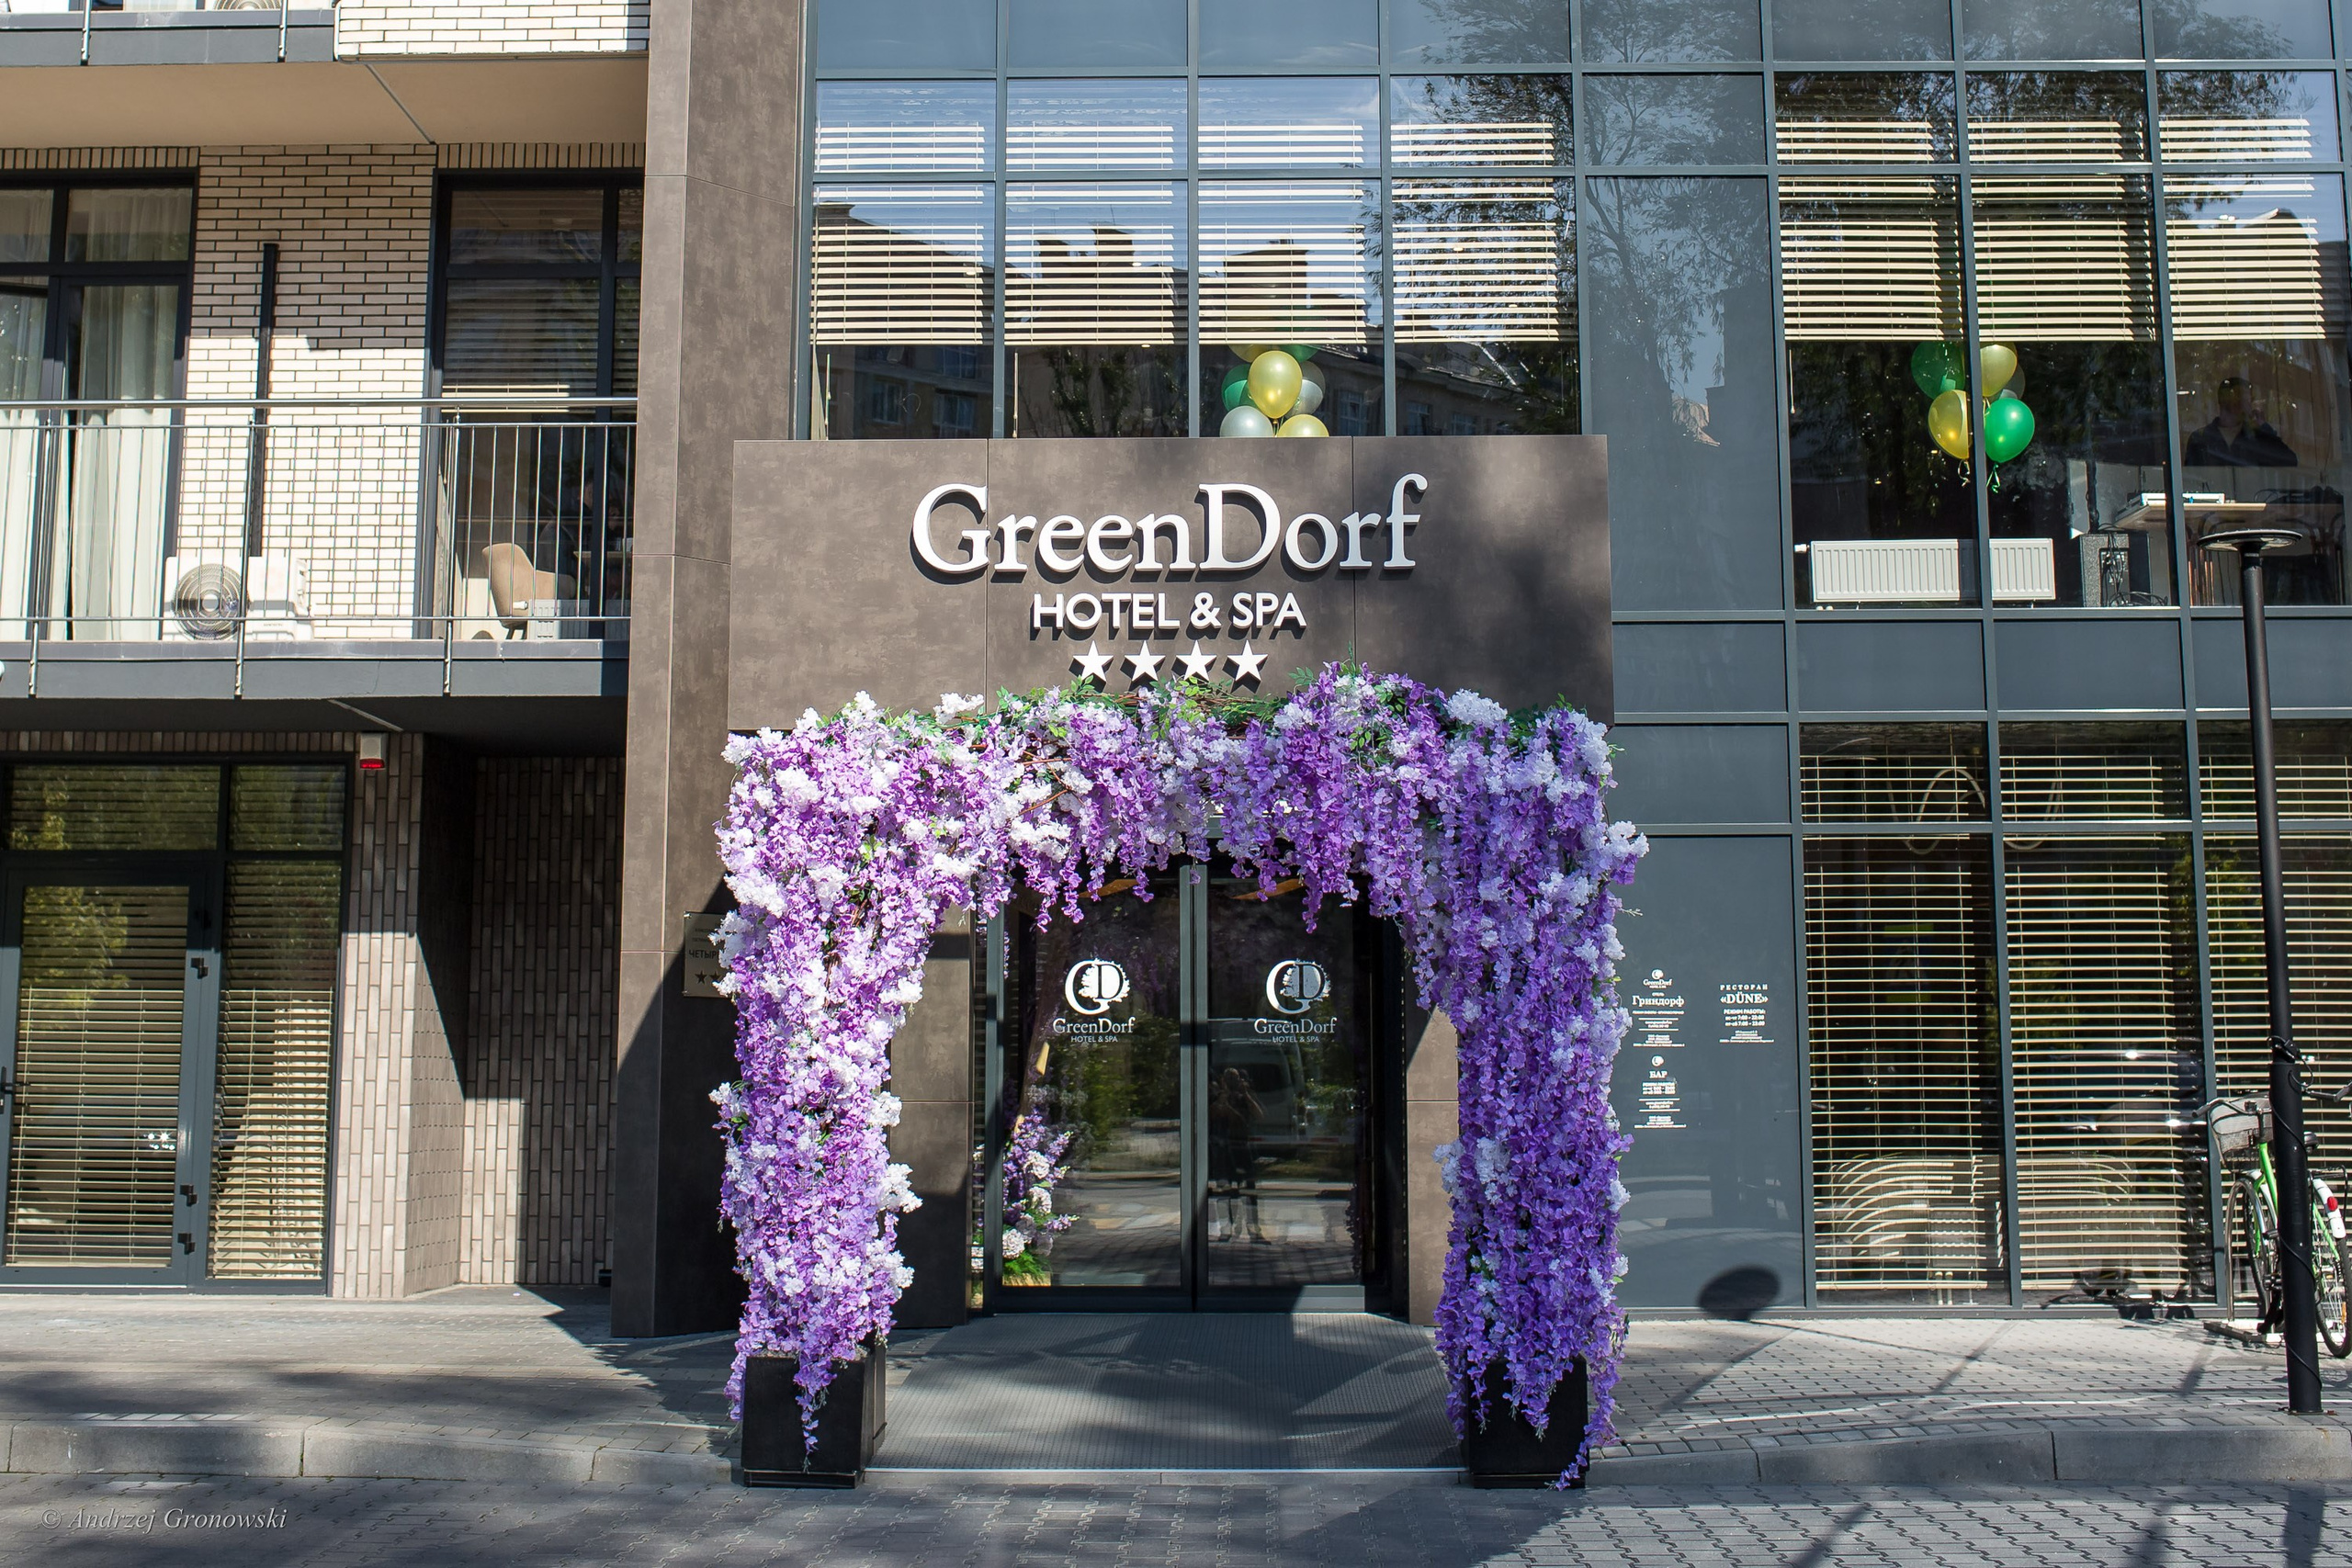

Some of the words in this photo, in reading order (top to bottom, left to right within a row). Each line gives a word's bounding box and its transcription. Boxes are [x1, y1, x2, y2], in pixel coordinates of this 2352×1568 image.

[912, 473, 1428, 572] GreenDorf
[1034, 592, 1180, 630] HOTEL
[1190, 592, 1221, 630] &
[1232, 592, 1306, 630] SPA
[689, 950, 719, 959] ЧЕТЫР
[1632, 996, 1684, 1007] Гриндорф
[1052, 1016, 1136, 1034] GreenDorf
[1253, 1016, 1338, 1034] GreenDorf
